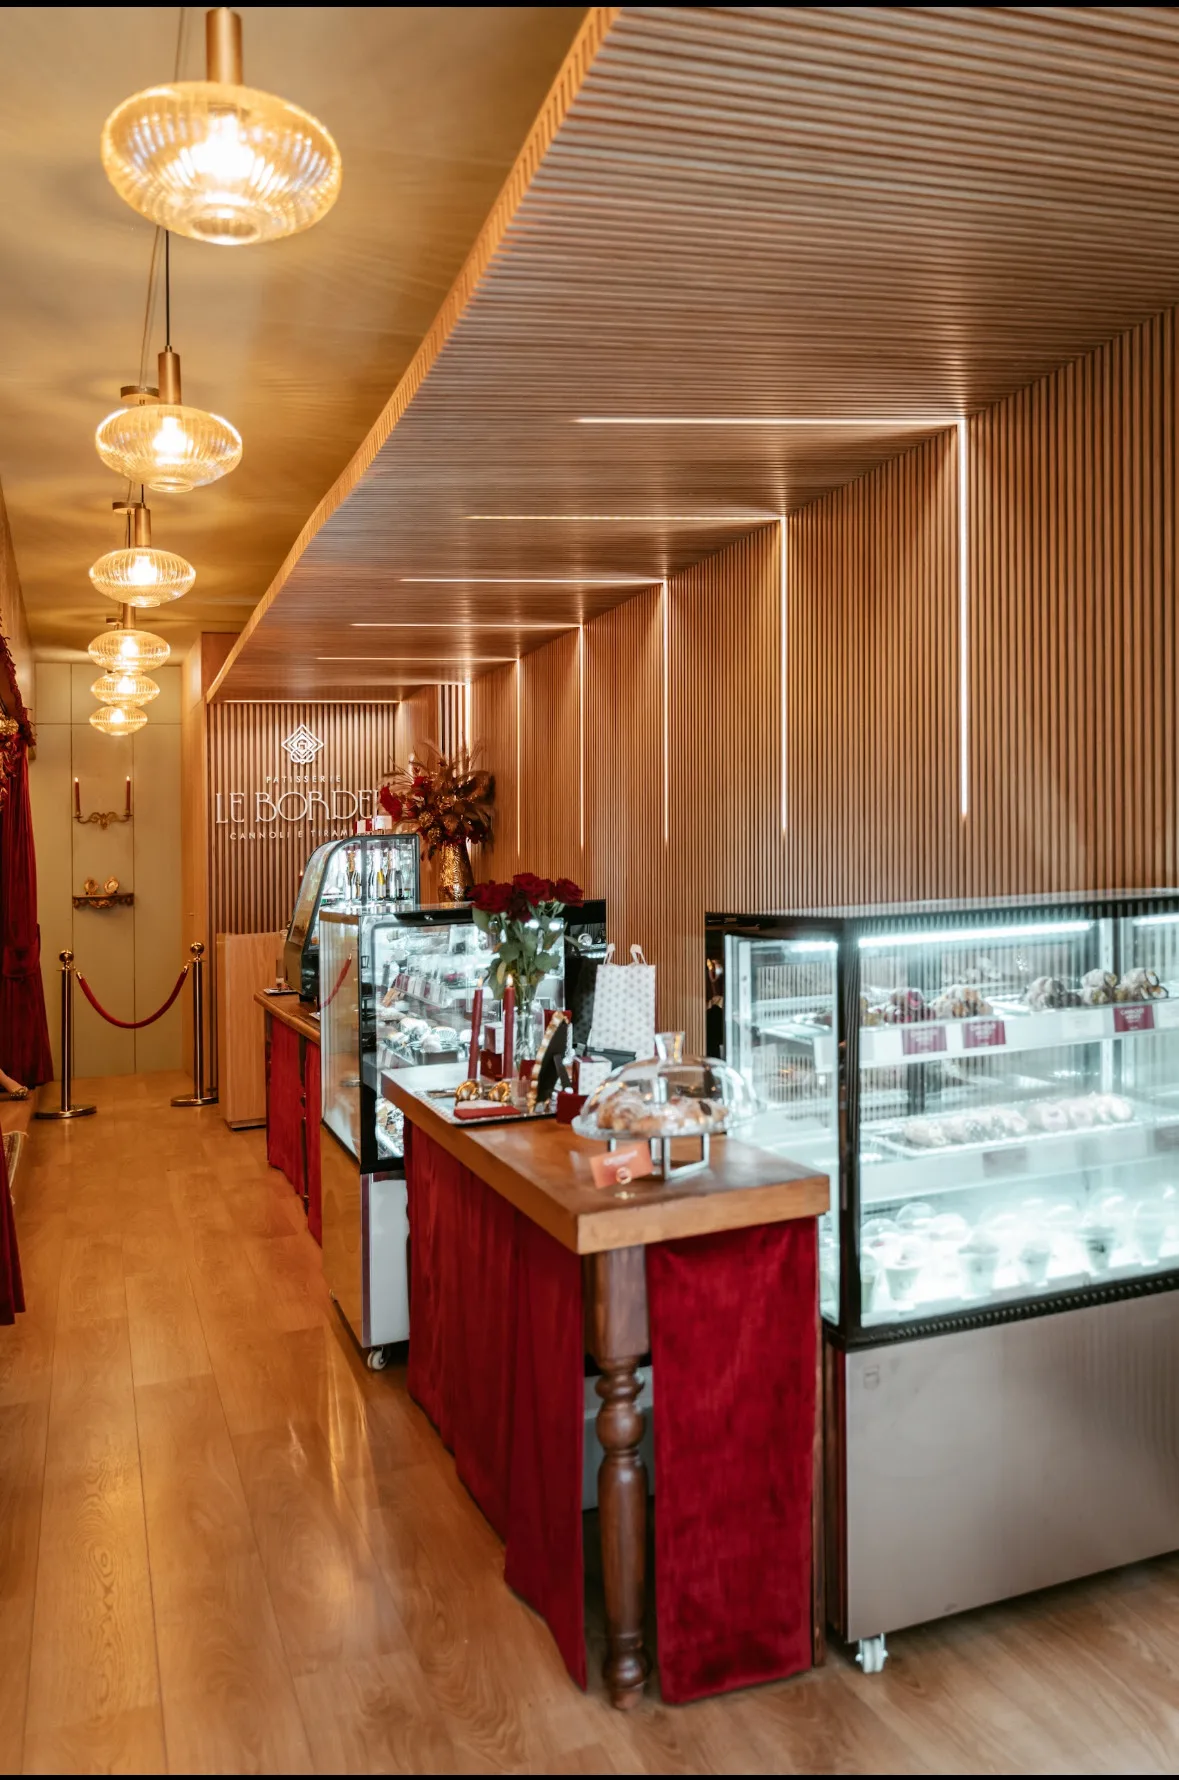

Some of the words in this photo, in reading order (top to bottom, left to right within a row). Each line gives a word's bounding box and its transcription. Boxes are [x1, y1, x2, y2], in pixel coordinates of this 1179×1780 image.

[266, 775, 341, 784] PATISSERIE
[215, 792, 245, 824] LE
[230, 831, 290, 840] CANNOLI
[298, 830, 305, 838] E
